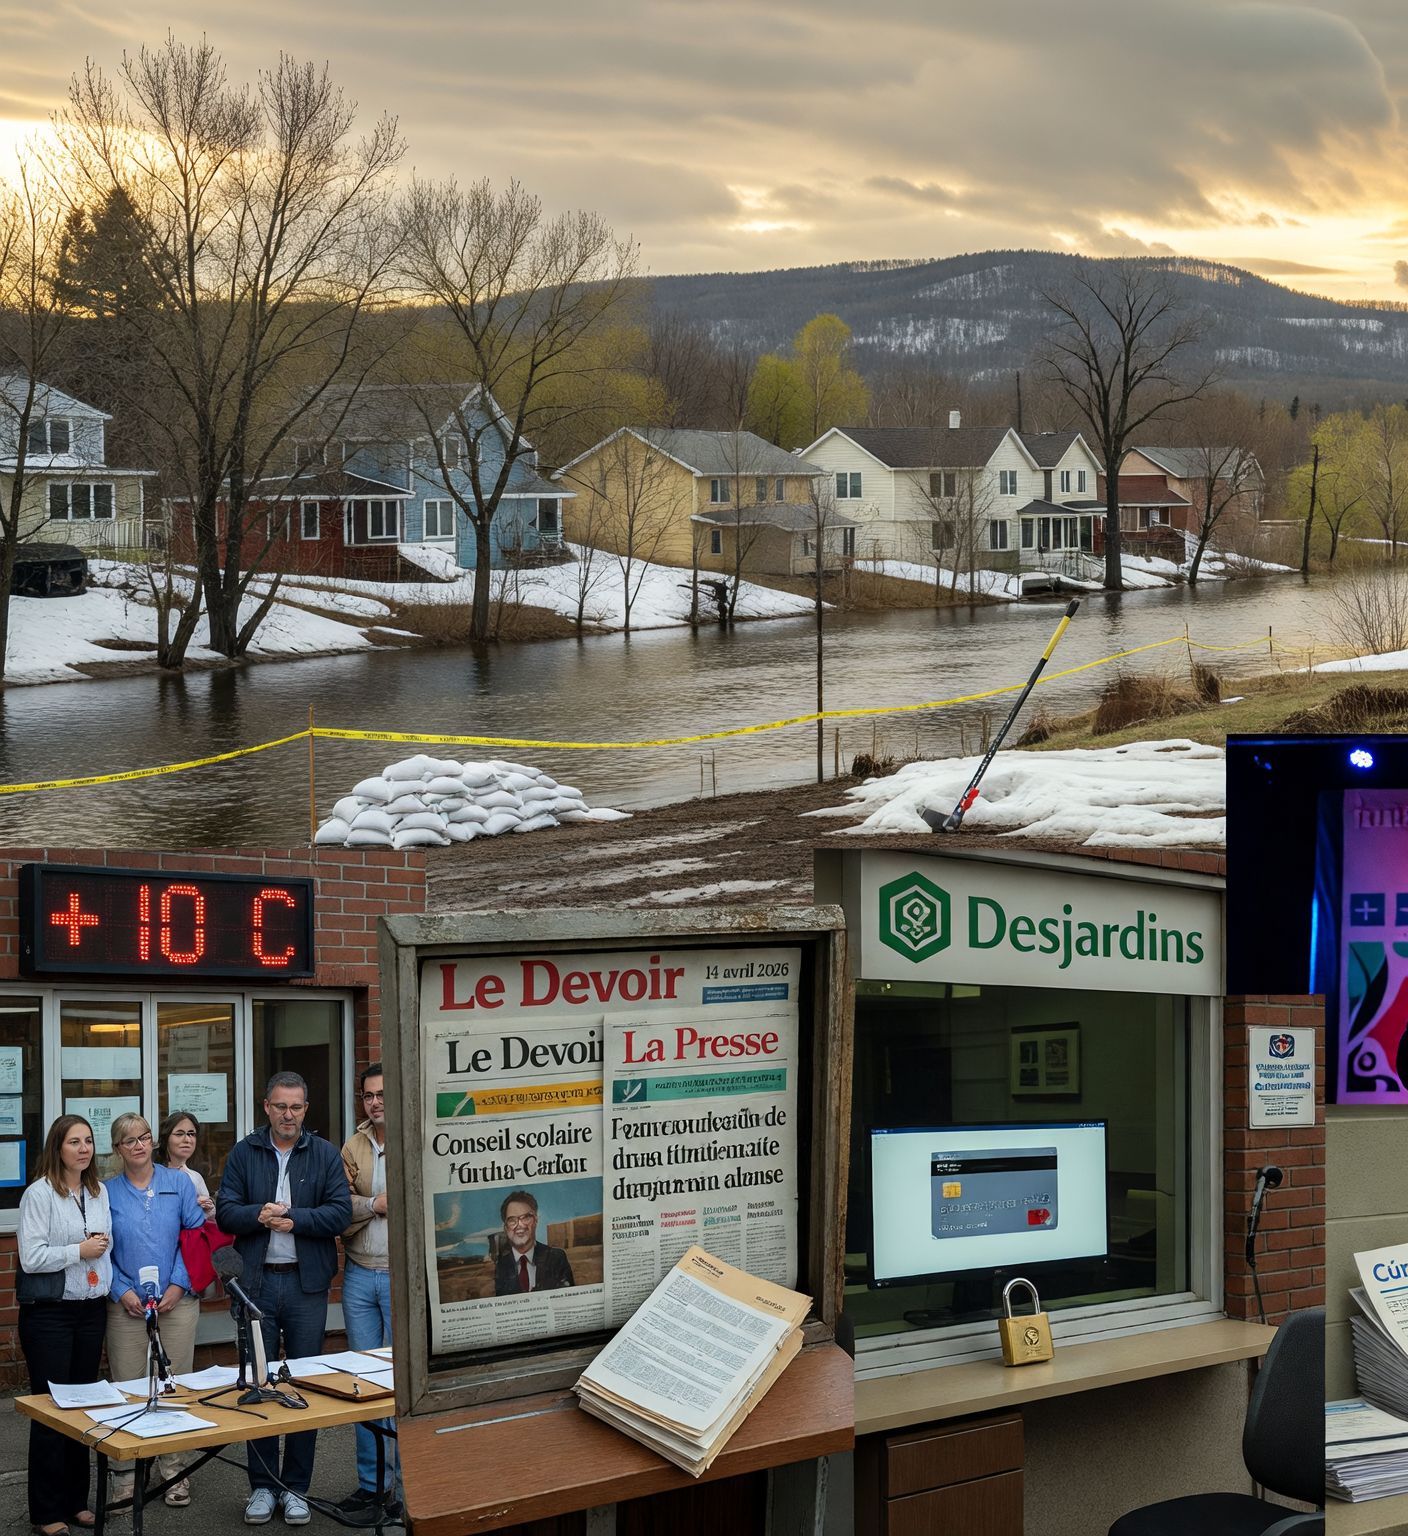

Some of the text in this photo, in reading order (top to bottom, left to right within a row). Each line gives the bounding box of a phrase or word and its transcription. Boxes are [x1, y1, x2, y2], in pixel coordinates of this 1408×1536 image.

[253, 889, 295, 965] C
[968, 896, 1205, 969] Desjardins
[439, 955, 685, 1010] Le Devoir
[706, 963, 789, 979] 14 avril 2026
[446, 1040, 492, 1074] Le
[622, 1027, 779, 1064] La Presse
[432, 1127, 511, 1157] Conseil
[515, 1122, 593, 1149] scolaire
